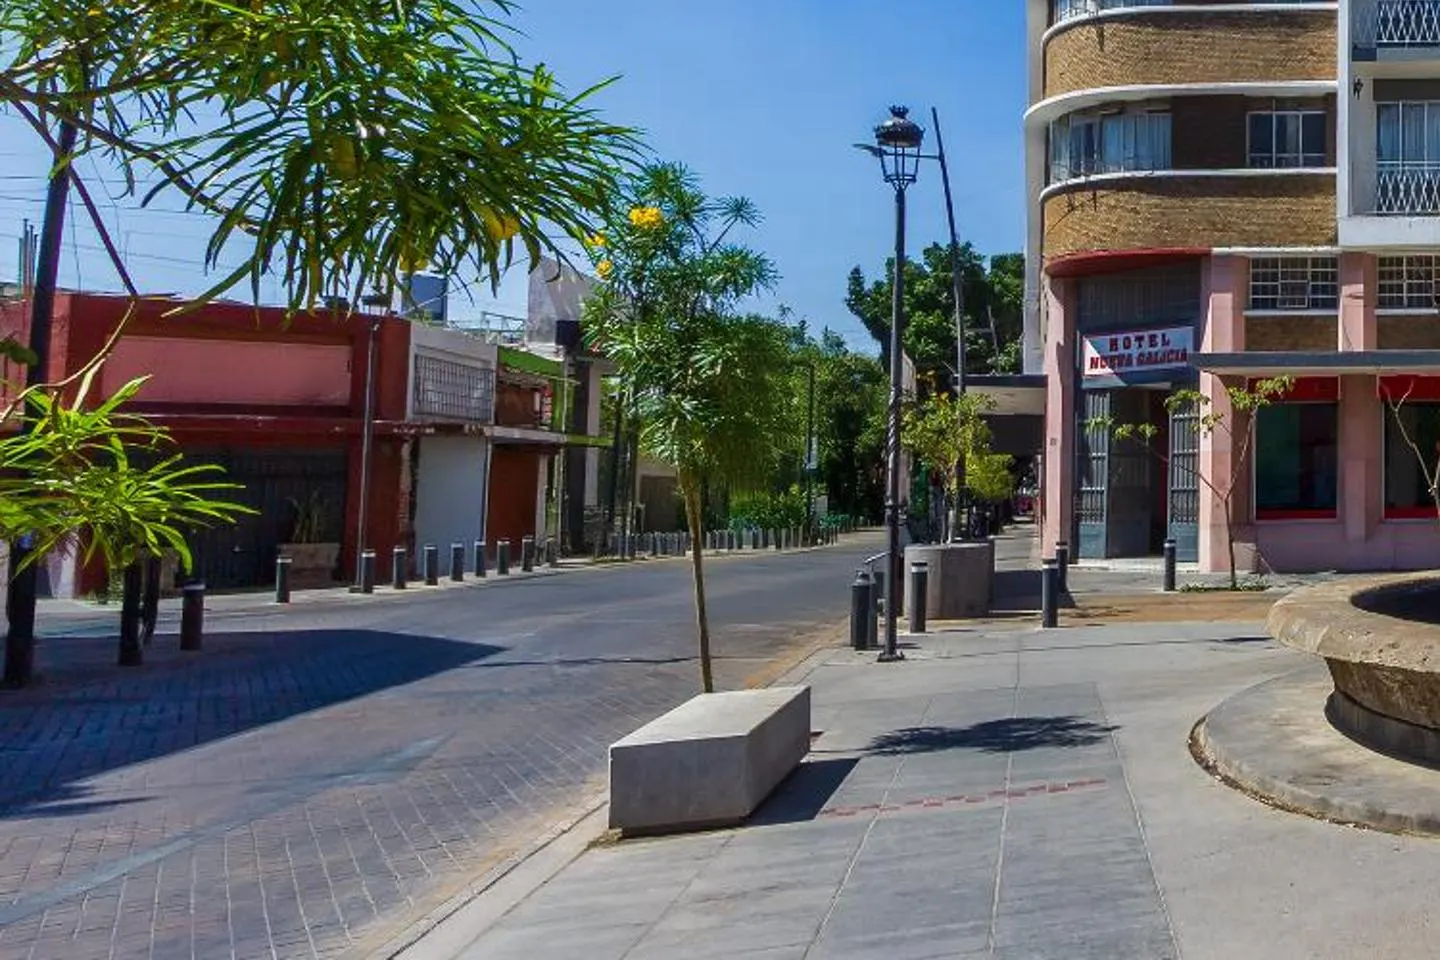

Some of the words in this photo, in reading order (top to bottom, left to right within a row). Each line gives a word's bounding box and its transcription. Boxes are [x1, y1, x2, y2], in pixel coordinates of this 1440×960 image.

[1109, 333, 1170, 351] HOTEL
[1090, 354, 1133, 369] NUEVA
[1137, 348, 1188, 364] GALICIA
